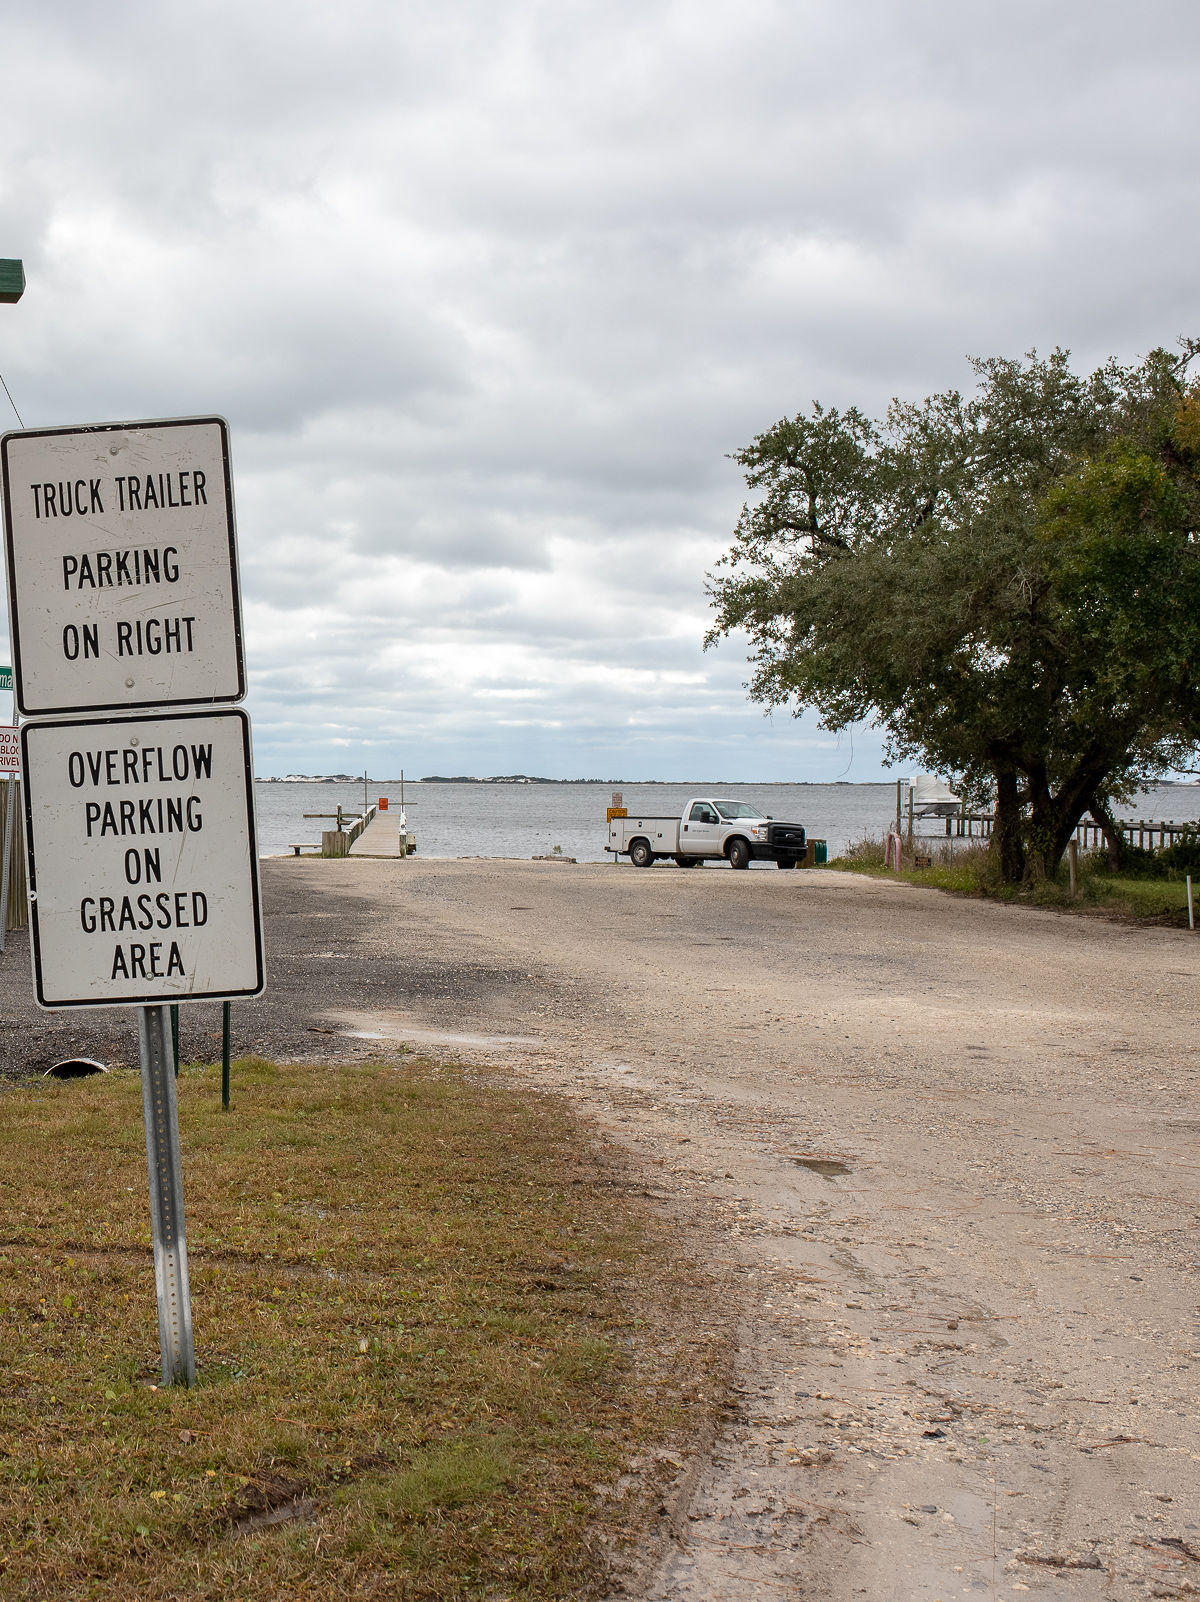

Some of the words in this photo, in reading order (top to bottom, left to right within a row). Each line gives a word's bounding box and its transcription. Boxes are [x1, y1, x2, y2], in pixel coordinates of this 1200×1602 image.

[30, 478, 104, 519] TRUCK
[115, 470, 208, 512] TRAILER
[62, 546, 180, 590] PARKING
[62, 623, 100, 661] ON
[116, 616, 196, 657] RIGHT
[68, 743, 213, 788] OVERFLOW
[85, 795, 203, 837] PARKING
[124, 848, 162, 885] ON
[80, 891, 208, 934] GRASSED
[111, 941, 185, 980] AREA
